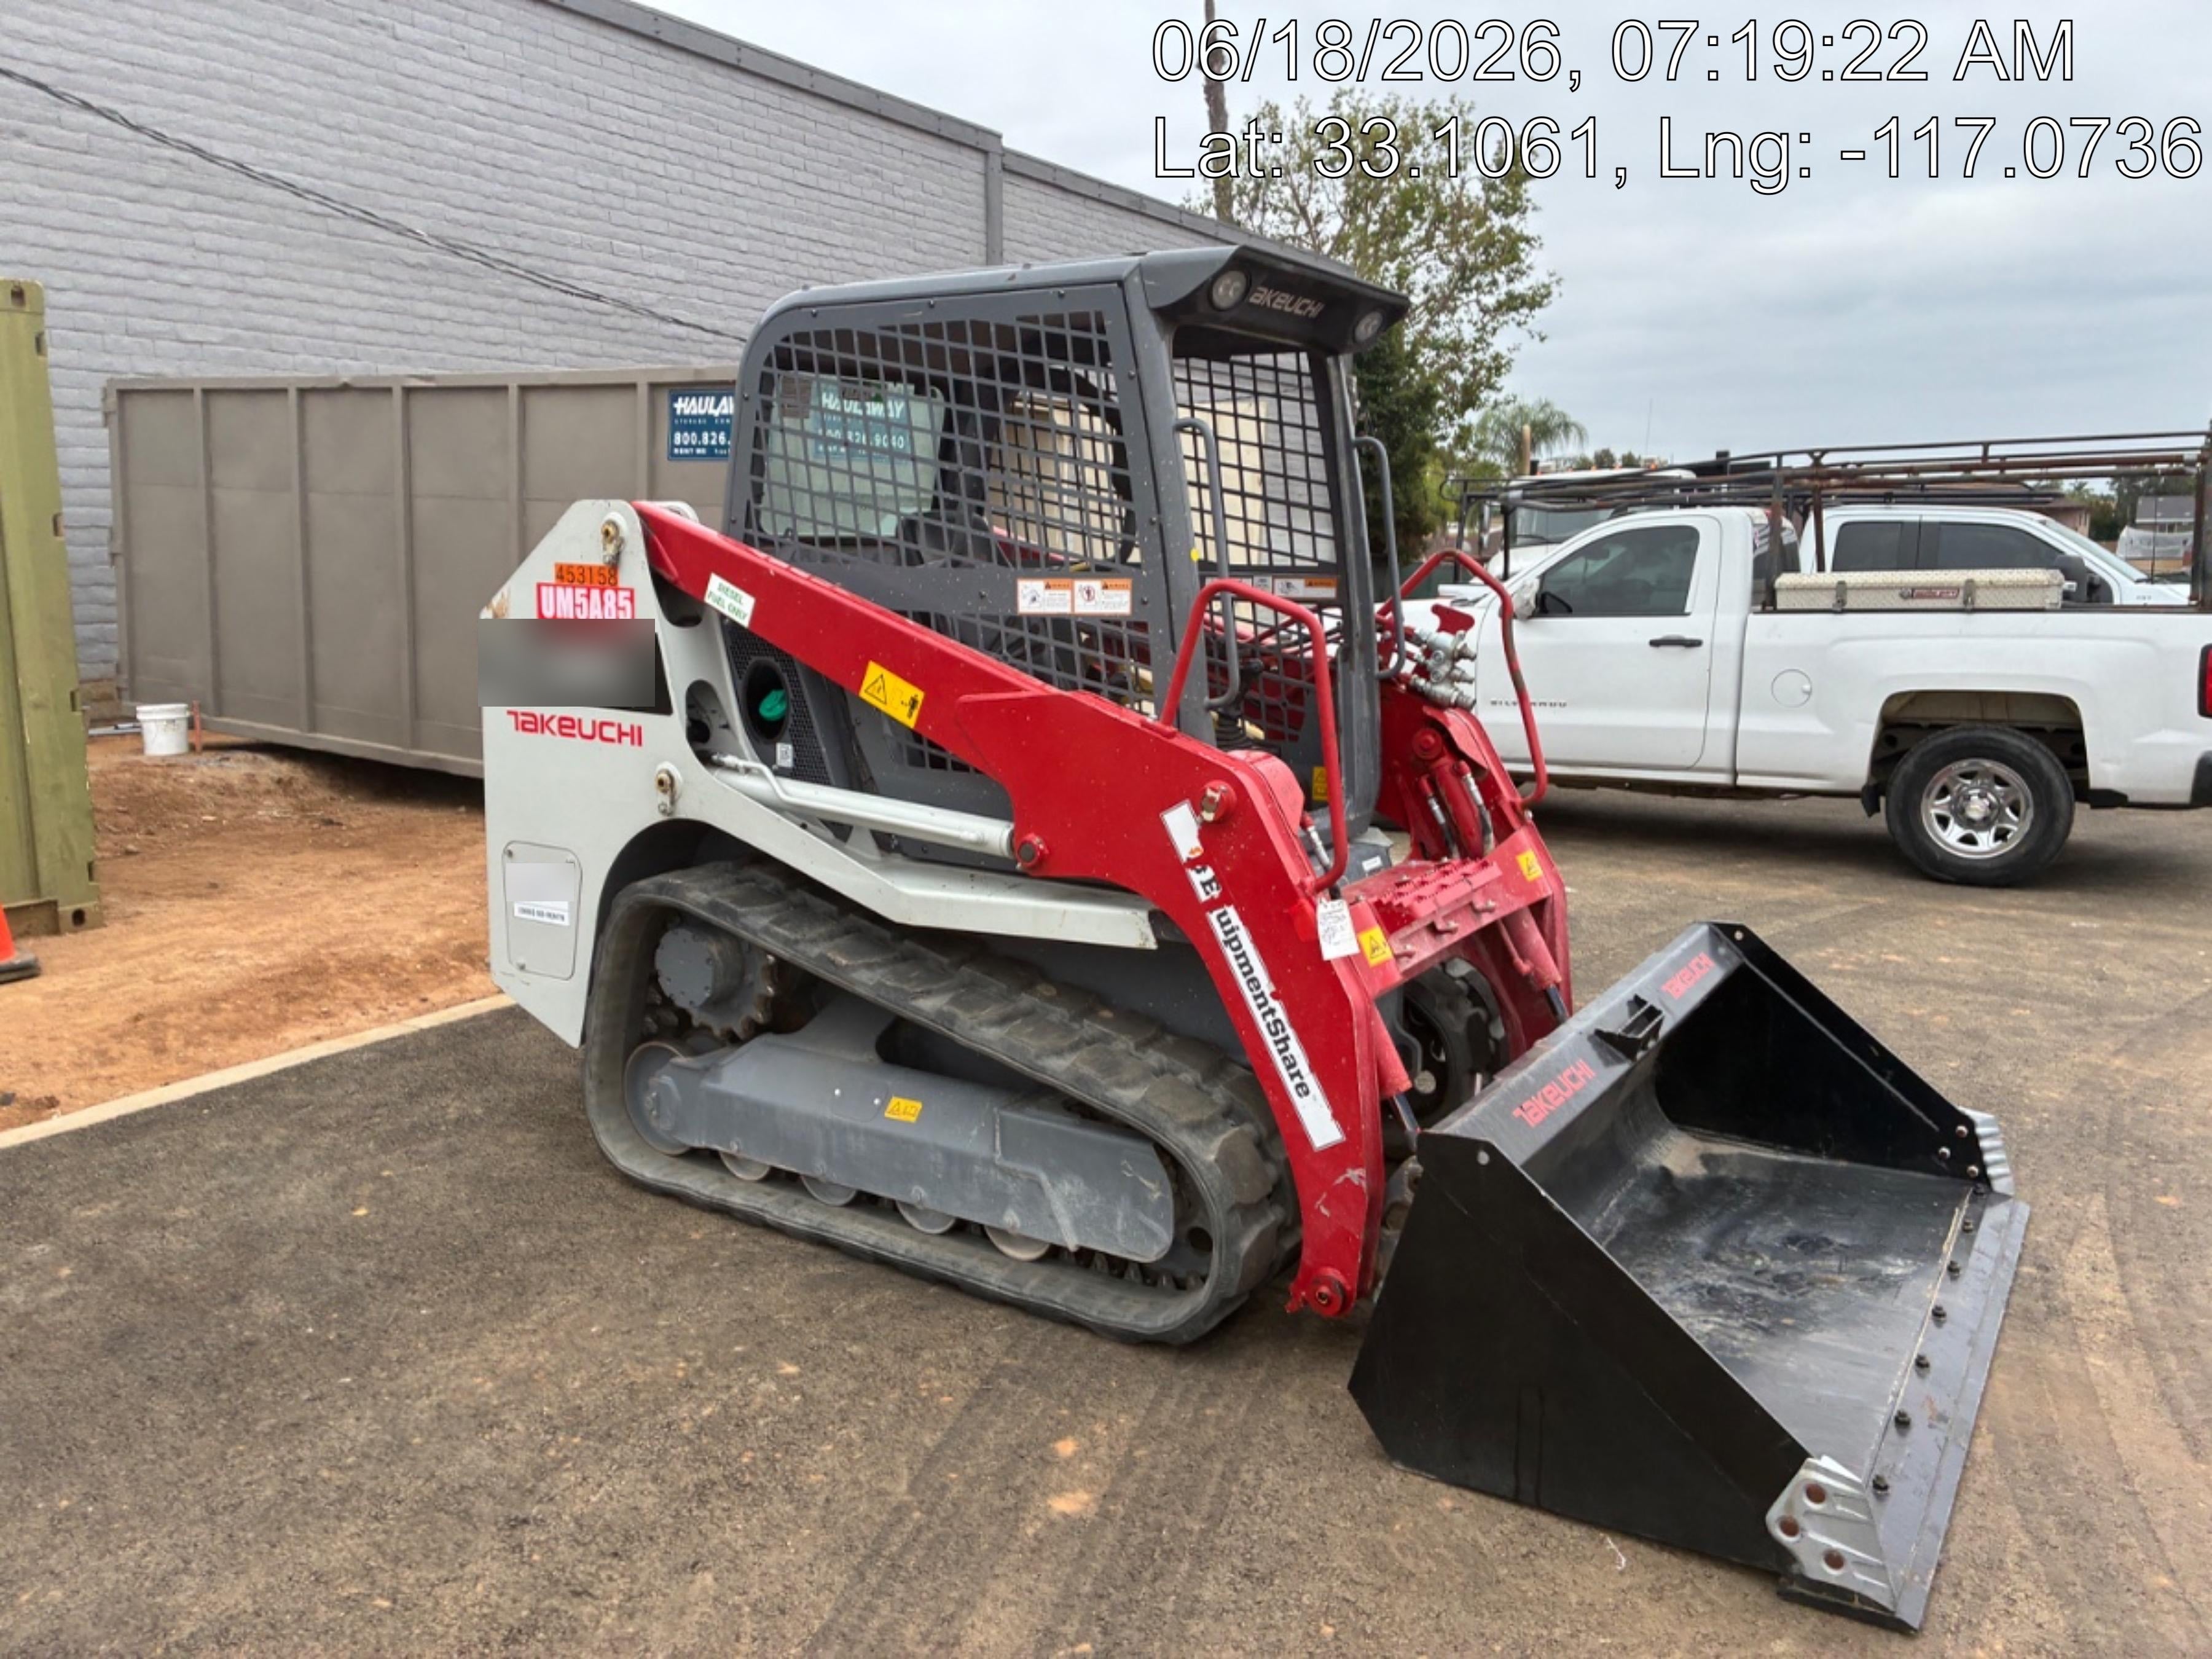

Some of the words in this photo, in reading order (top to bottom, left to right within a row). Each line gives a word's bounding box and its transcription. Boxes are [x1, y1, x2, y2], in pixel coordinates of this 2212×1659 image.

[1249, 286, 1325, 318] AKEUCHI
[555, 565, 618, 586] 453158
[506, 709, 643, 747] TAKEUCHI
[1513, 1058, 1596, 1128] TAKEUCHI
